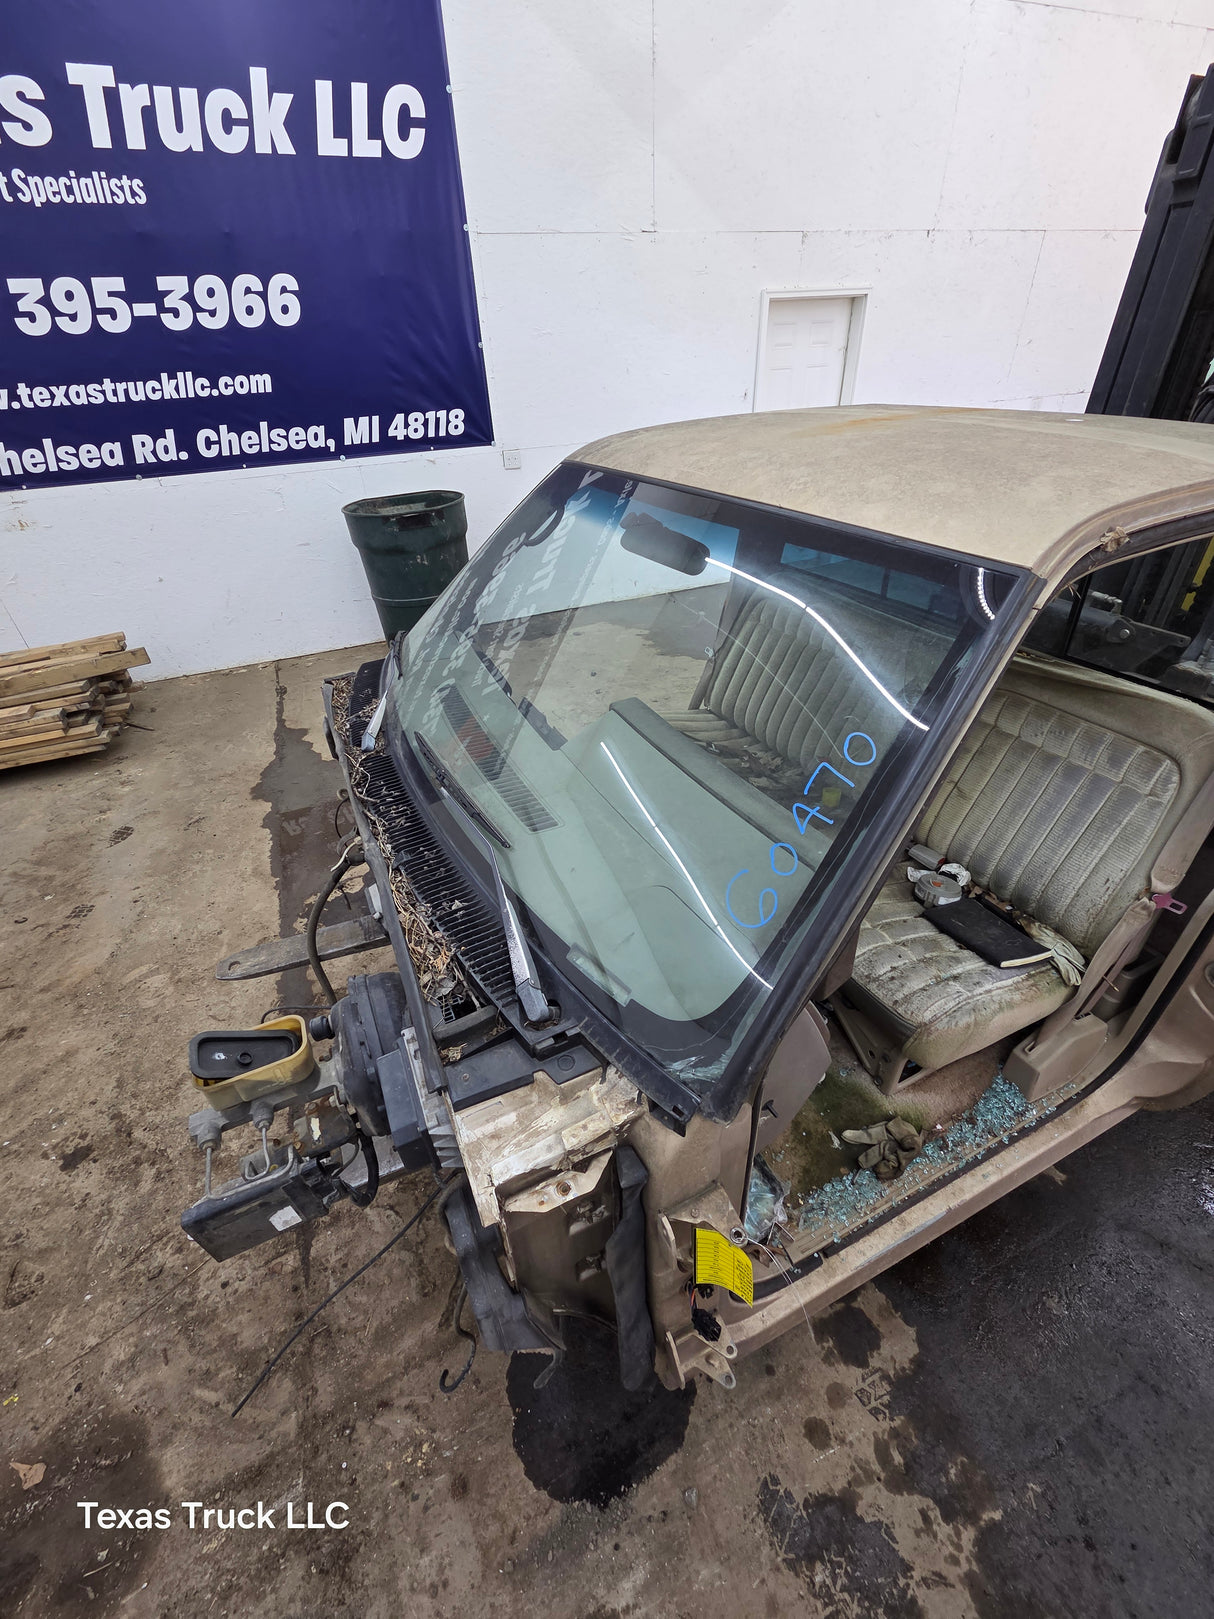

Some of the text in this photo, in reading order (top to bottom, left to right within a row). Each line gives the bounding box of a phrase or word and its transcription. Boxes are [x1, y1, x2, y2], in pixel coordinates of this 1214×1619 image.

[64, 61, 297, 157] Truck
[314, 79, 426, 160] LLC
[11, 168, 147, 208] Specialists
[6, 272, 301, 337] 395-3966
[131, 428, 189, 465] Rd.
[196, 421, 336, 458] Chelsea,
[343, 415, 380, 446] MI
[387, 408, 465, 441] 48118
